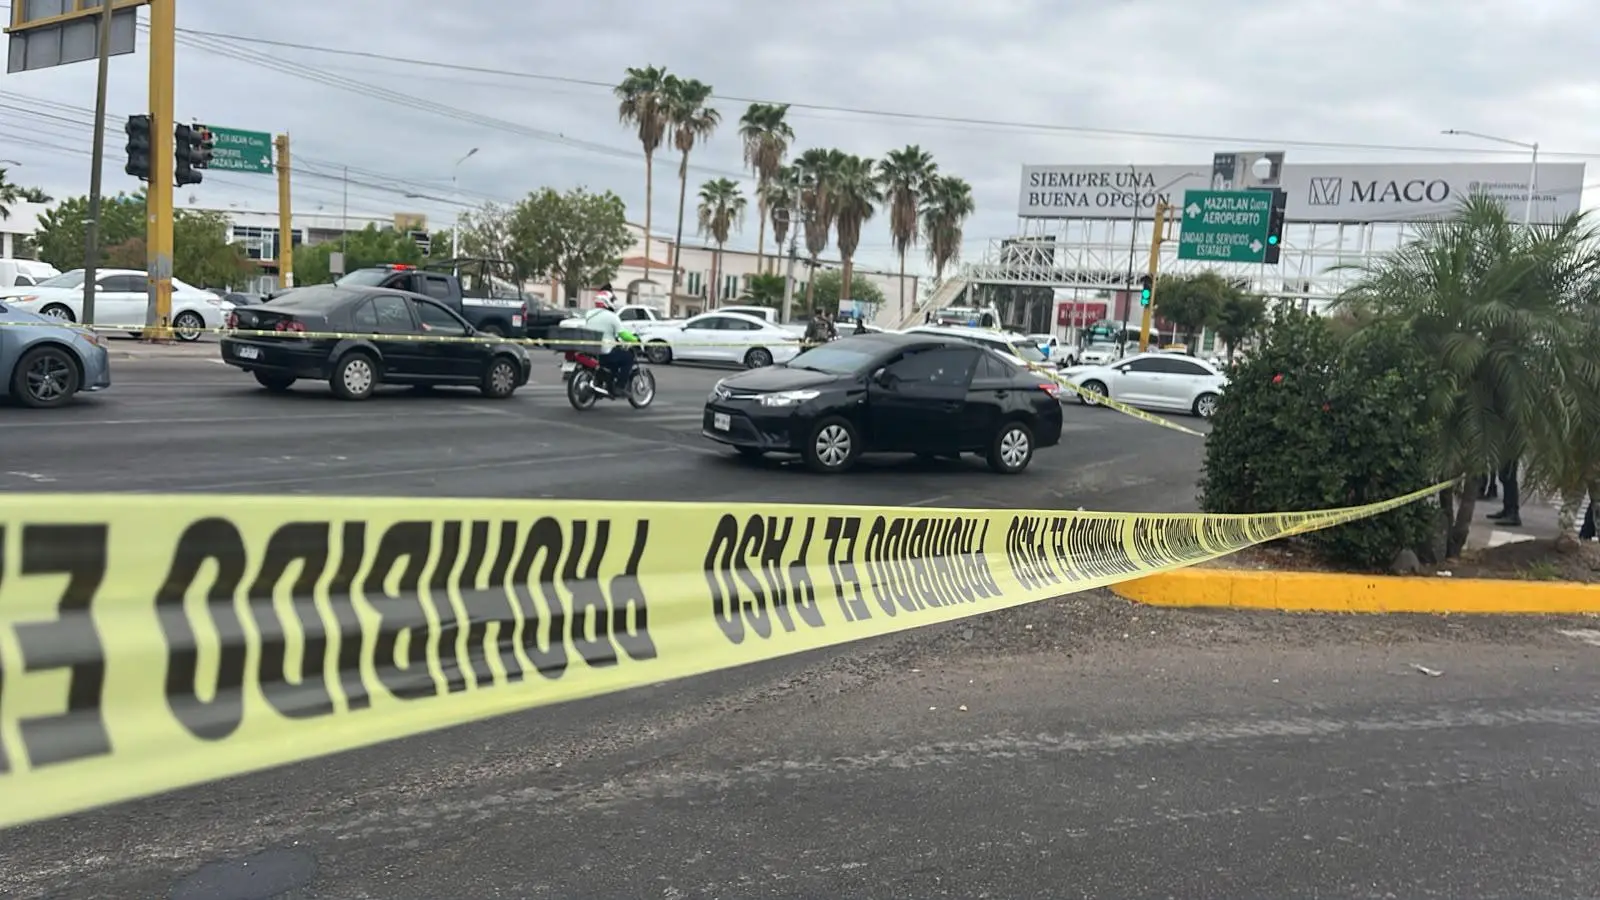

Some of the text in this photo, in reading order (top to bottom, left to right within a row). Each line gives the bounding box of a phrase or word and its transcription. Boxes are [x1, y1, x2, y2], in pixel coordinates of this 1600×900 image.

[1029, 172, 1156, 187] SIEMPRE UNA
[1029, 189, 1170, 208] BUENA OPCIÓN
[1203, 197, 1249, 211] MAZATLAN
[1350, 179, 1450, 203] MACO
[1181, 232, 1250, 246] UNIDAD DE SERVICIOS
[1202, 211, 1260, 226] AEROPUERTO
[1196, 245, 1231, 257] ESTATALES
[704, 513, 825, 645] PASO
[824, 516, 873, 622] EL
[864, 515, 1003, 617] PROHIBIDO
[1006, 515, 1061, 591] PASO
[1050, 517, 1081, 582] EL
[1067, 516, 1141, 580] PROHIBIDO
[0, 522, 113, 774] E
[154, 516, 658, 742] PROHIBIDO
